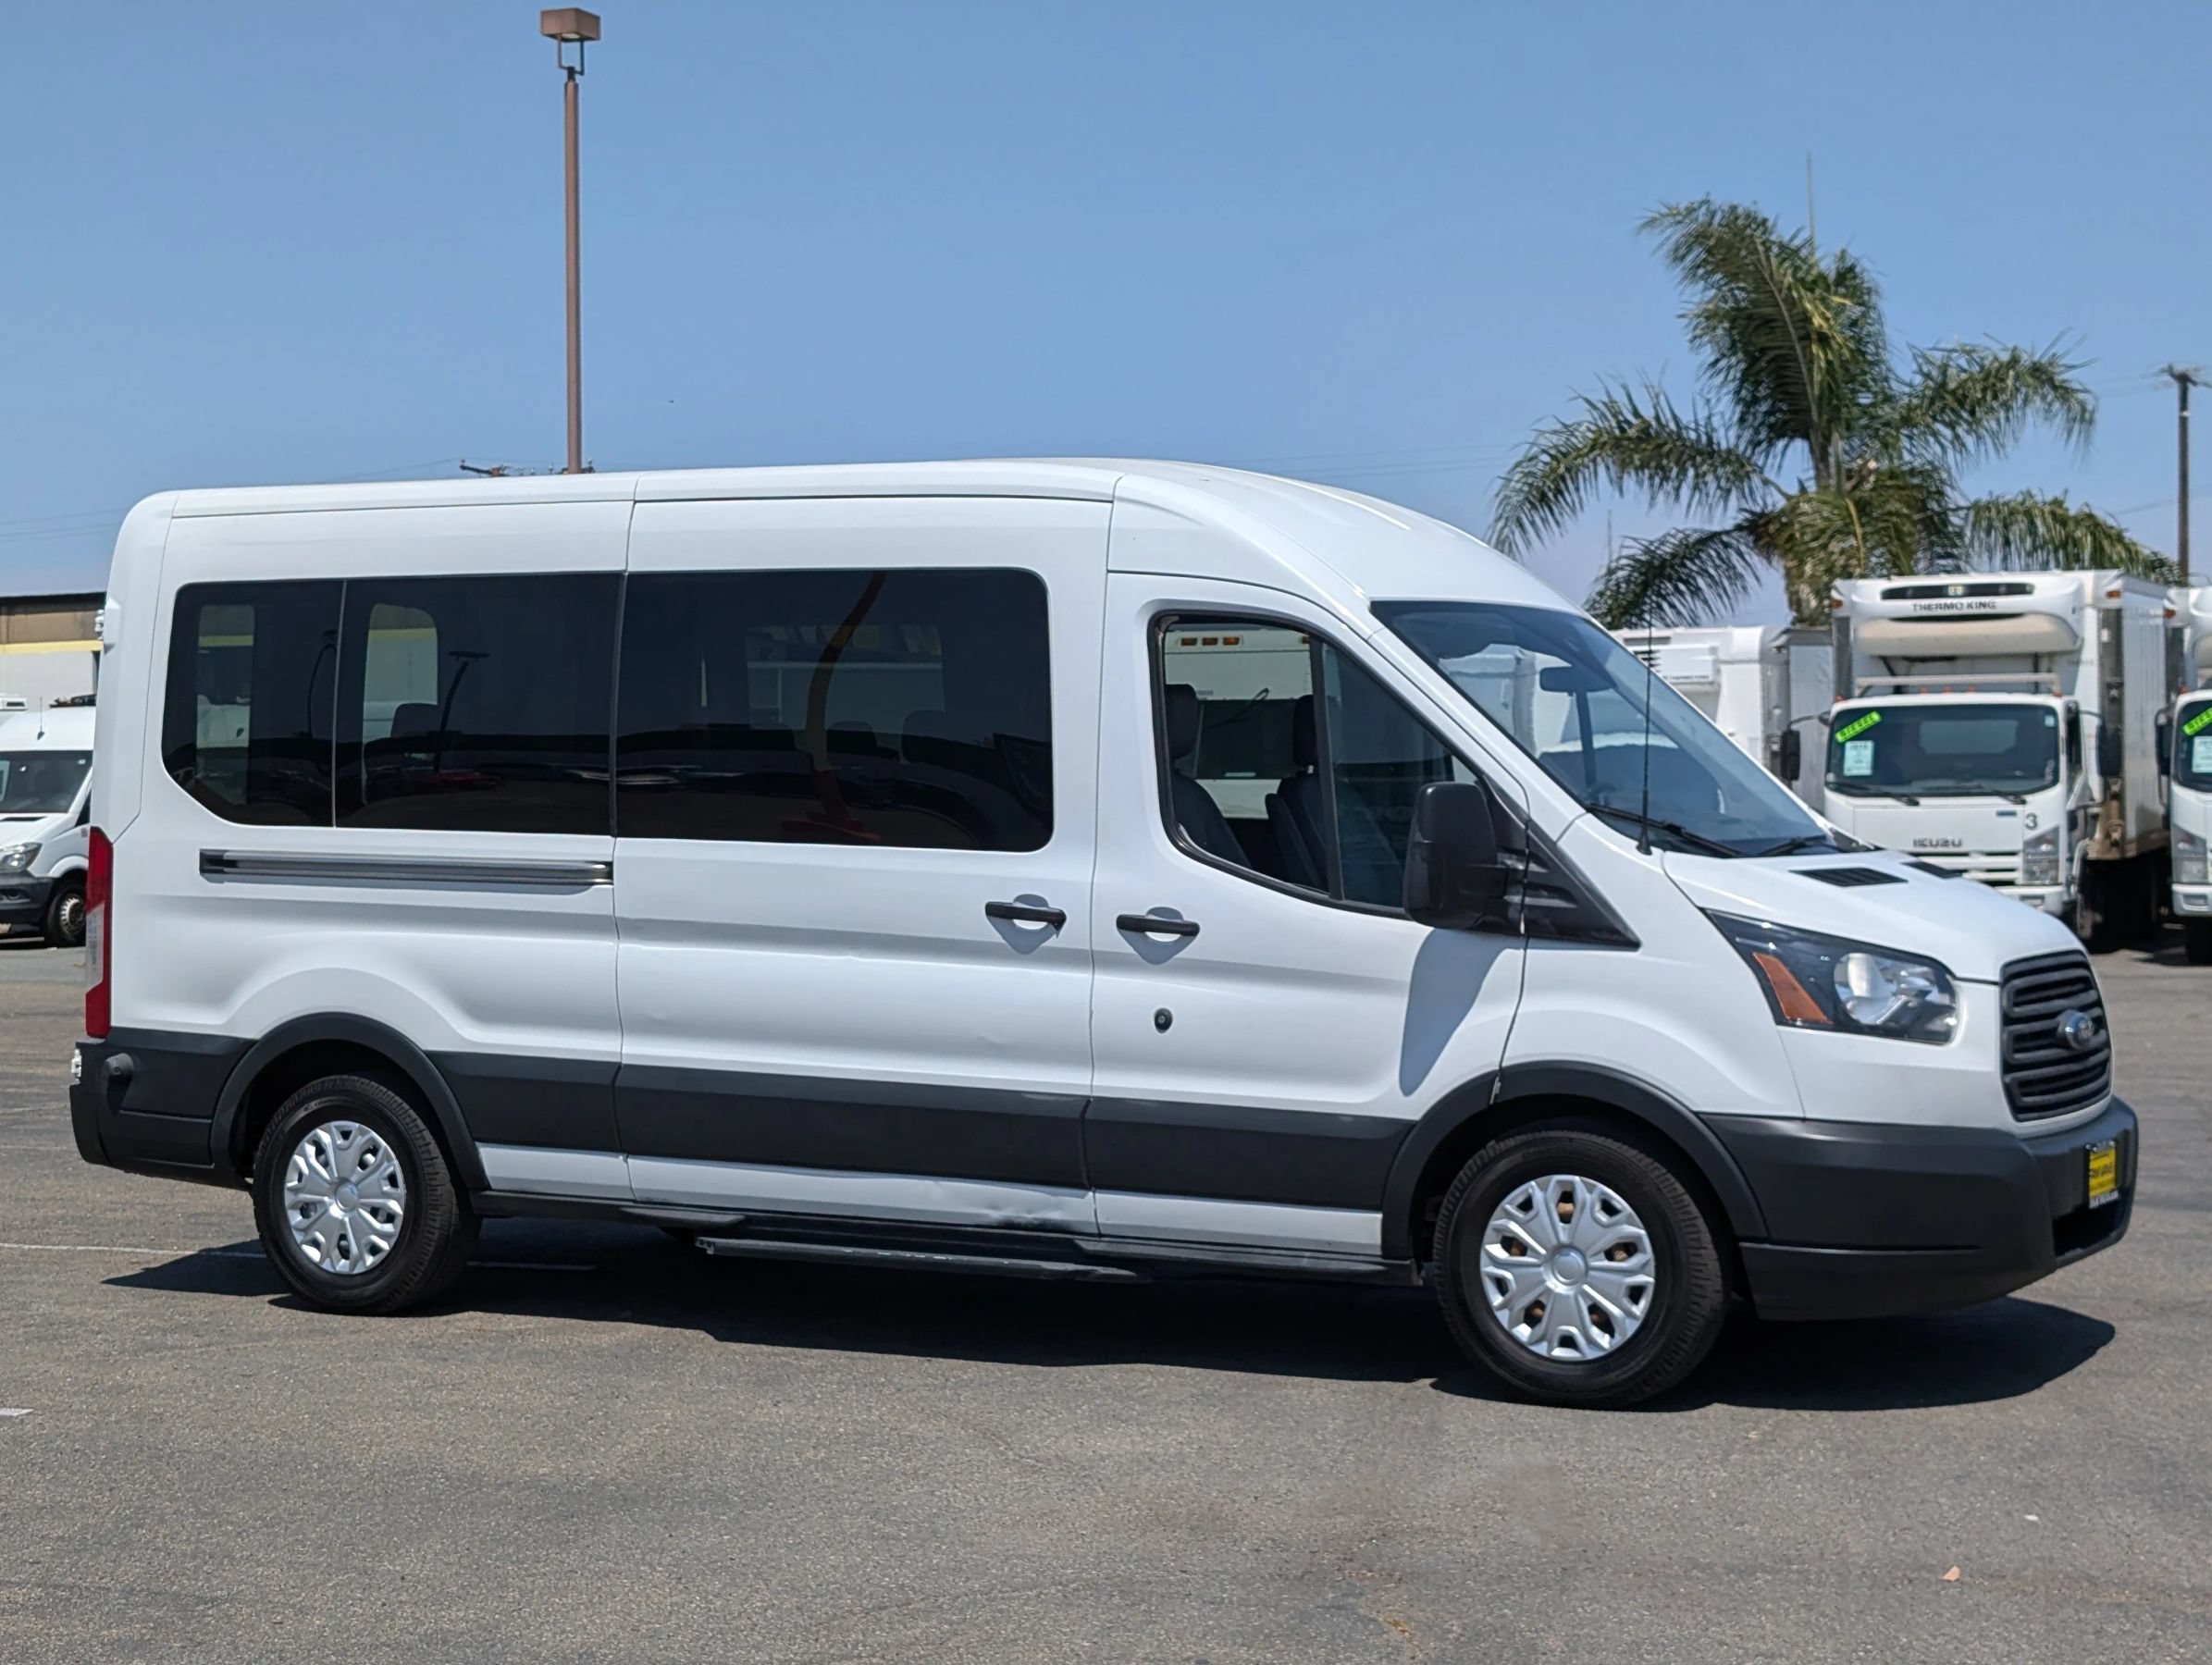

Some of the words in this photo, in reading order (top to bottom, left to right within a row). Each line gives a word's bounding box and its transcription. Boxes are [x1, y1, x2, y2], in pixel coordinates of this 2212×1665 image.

[1912, 601, 1964, 611] THERMO
[1966, 600, 1996, 610] KING
[2025, 812, 2038, 830] 3
[1912, 838, 1962, 847] ISUZU
